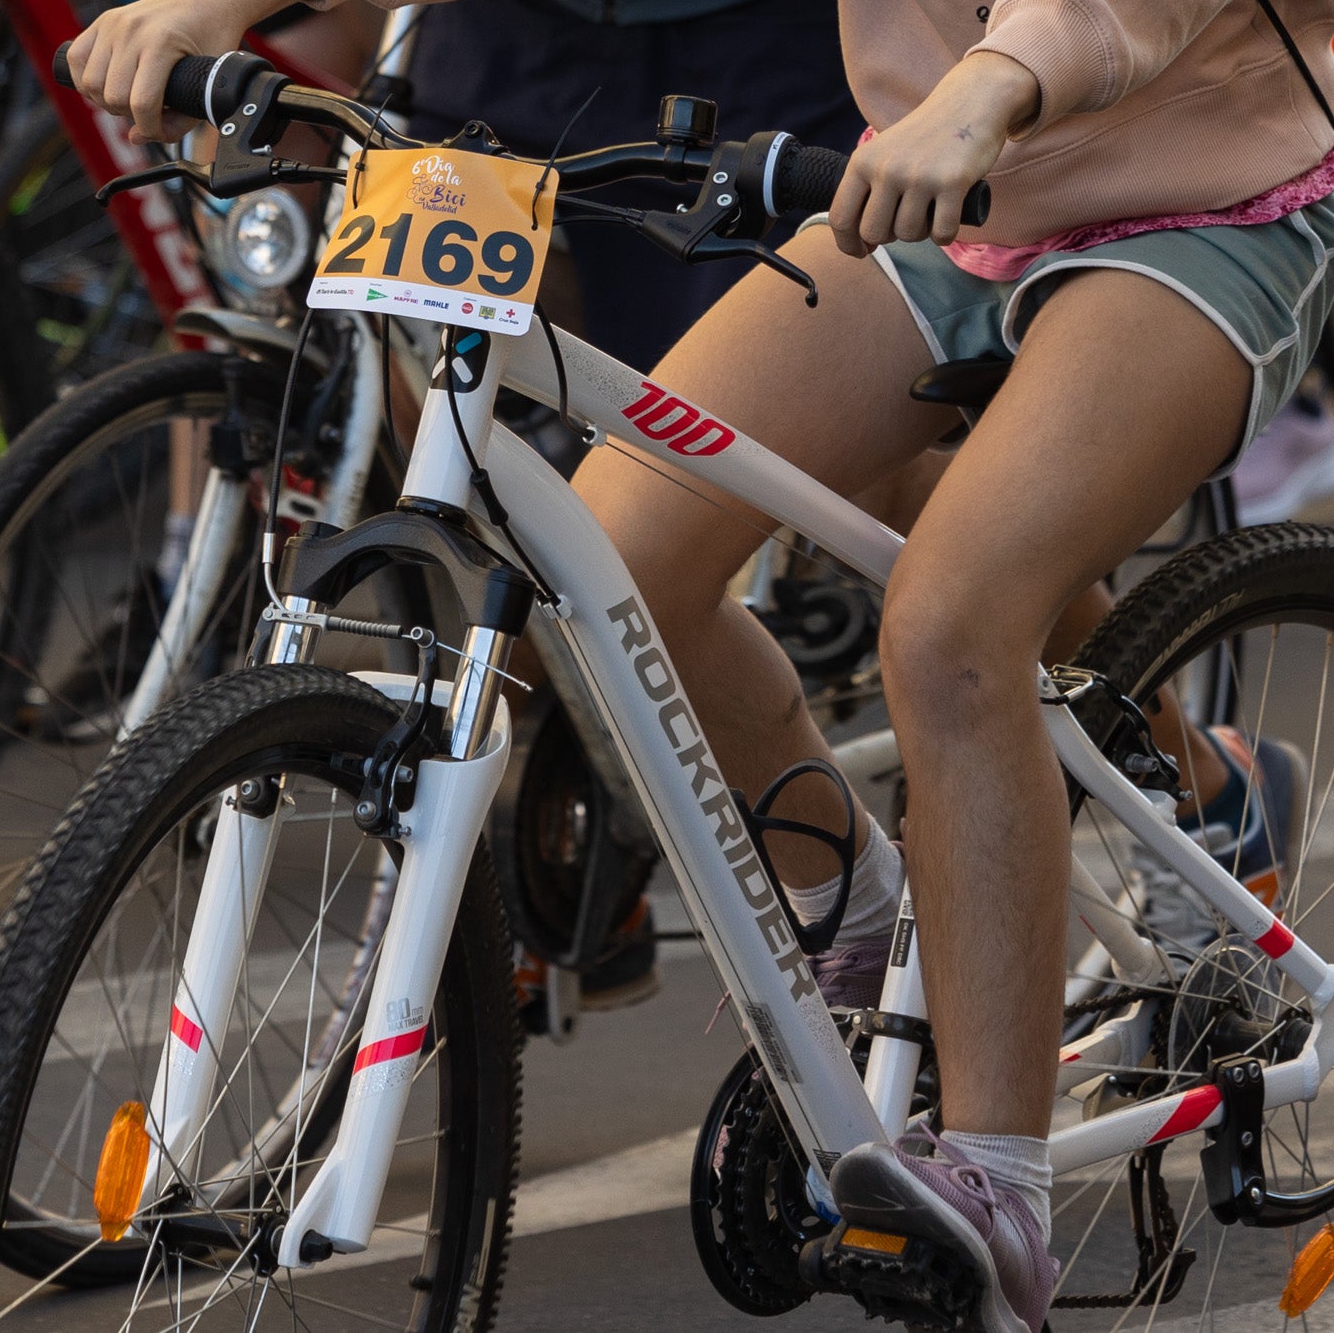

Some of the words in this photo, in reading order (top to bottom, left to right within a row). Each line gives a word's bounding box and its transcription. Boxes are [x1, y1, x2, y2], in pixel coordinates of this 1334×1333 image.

[430, 172, 444, 183] de
[446, 166, 463, 186] la
[429, 184, 466, 206] Bici
[323, 213, 534, 296] 2169
[394, 296, 419, 304] MAPFRE
[423, 299, 449, 310] MAHLE
[621, 381, 736, 456] 100
[606, 595, 814, 1003] ROCKRIDER
[386, 997, 411, 1023] 80
